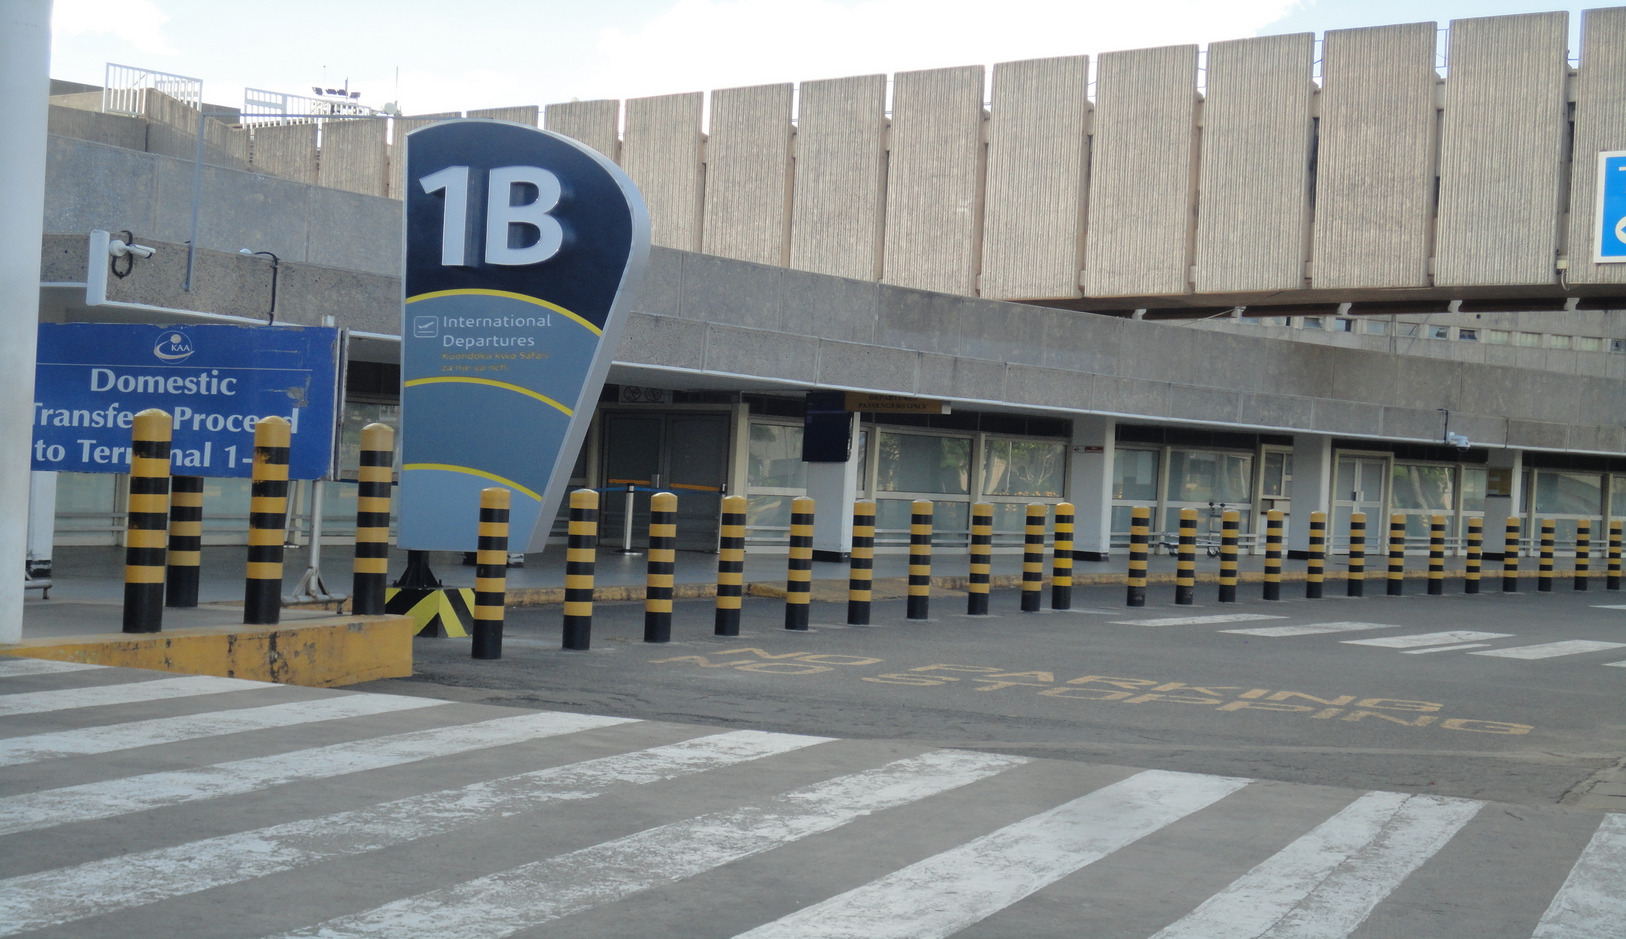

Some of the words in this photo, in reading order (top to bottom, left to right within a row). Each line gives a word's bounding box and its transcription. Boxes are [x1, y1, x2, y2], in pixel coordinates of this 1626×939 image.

[419, 165, 564, 267] 1B
[442, 314, 552, 328] International
[170, 343, 191, 353] KAA
[442, 334, 535, 350] Departures
[89, 368, 238, 397] Domestic
[32, 402, 134, 429] Transfe
[173, 406, 299, 434] Proced
[34, 439, 66, 463] to
[77, 439, 212, 468] Ternal
[714, 647, 886, 667] NO
[908, 663, 1445, 713] PARKING
[647, 655, 836, 675] NO
[860, 673, 1536, 736] STOPPING
